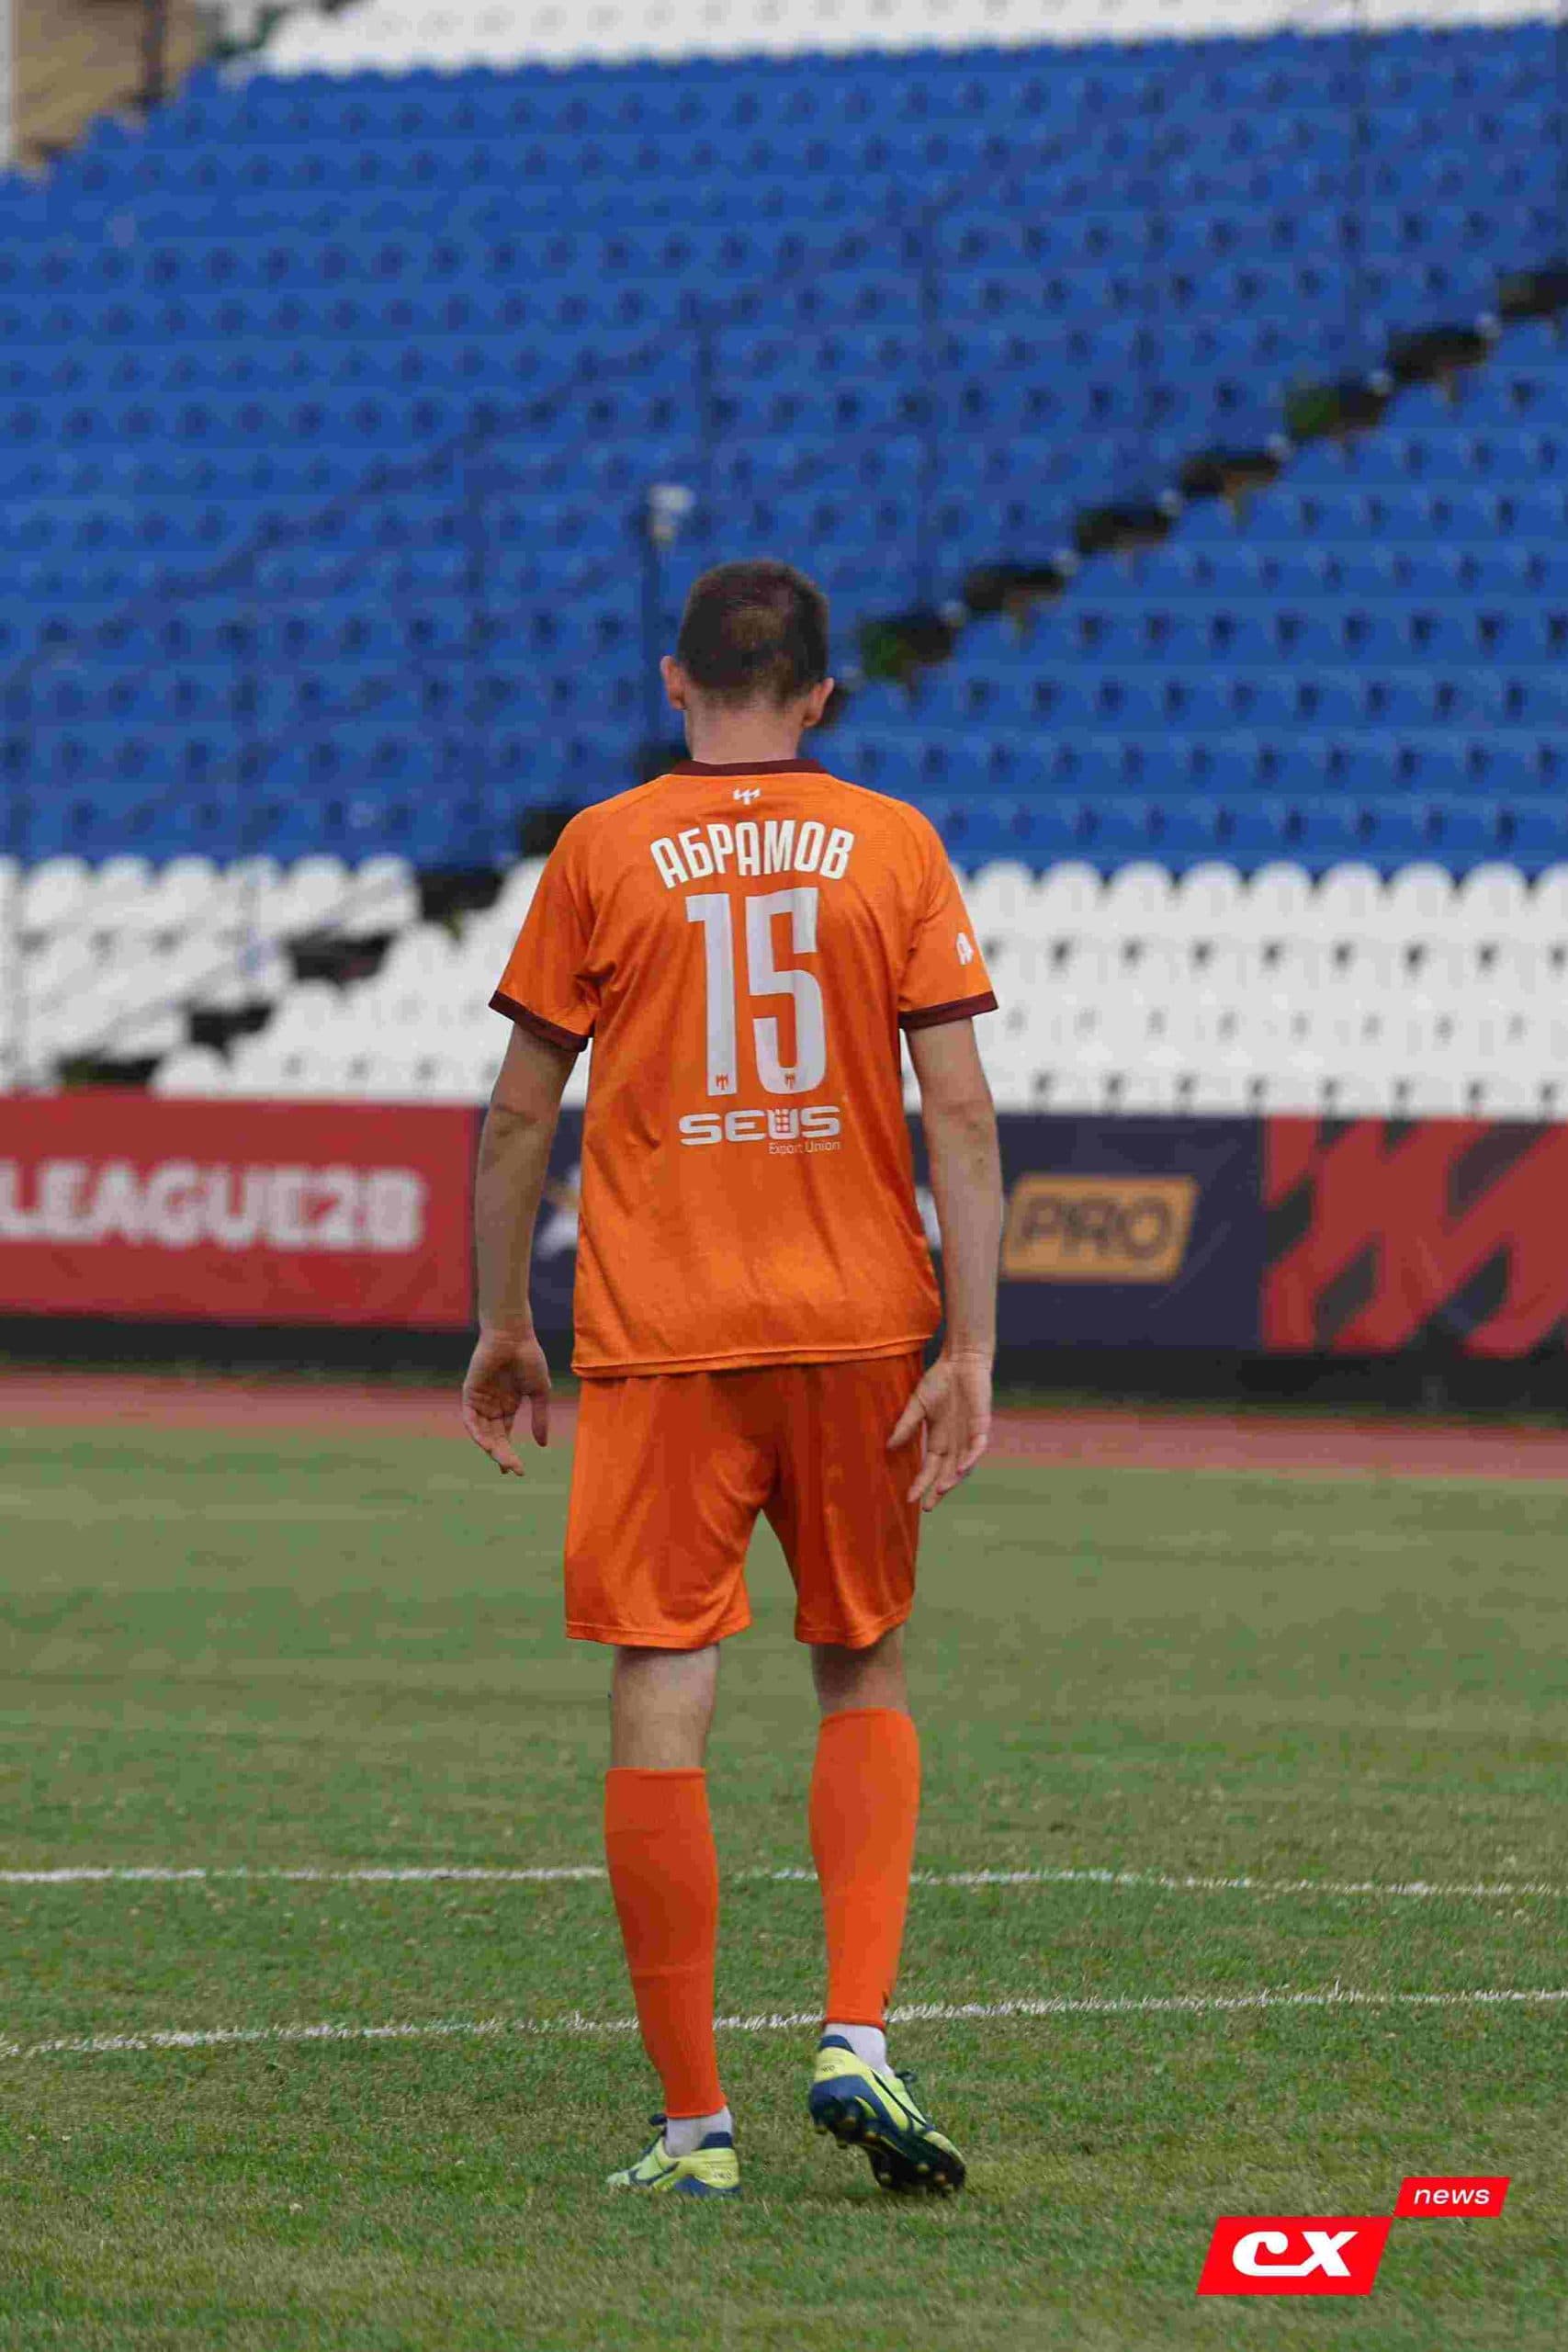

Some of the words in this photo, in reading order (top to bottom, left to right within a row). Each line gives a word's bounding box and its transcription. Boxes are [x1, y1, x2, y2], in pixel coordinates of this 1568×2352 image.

[650, 820, 855, 889] АБРАМОВ
[685, 888, 827, 1096] 15
[805, 1138, 841, 1154] Union
[1016, 1194, 1171, 1260] PRO
